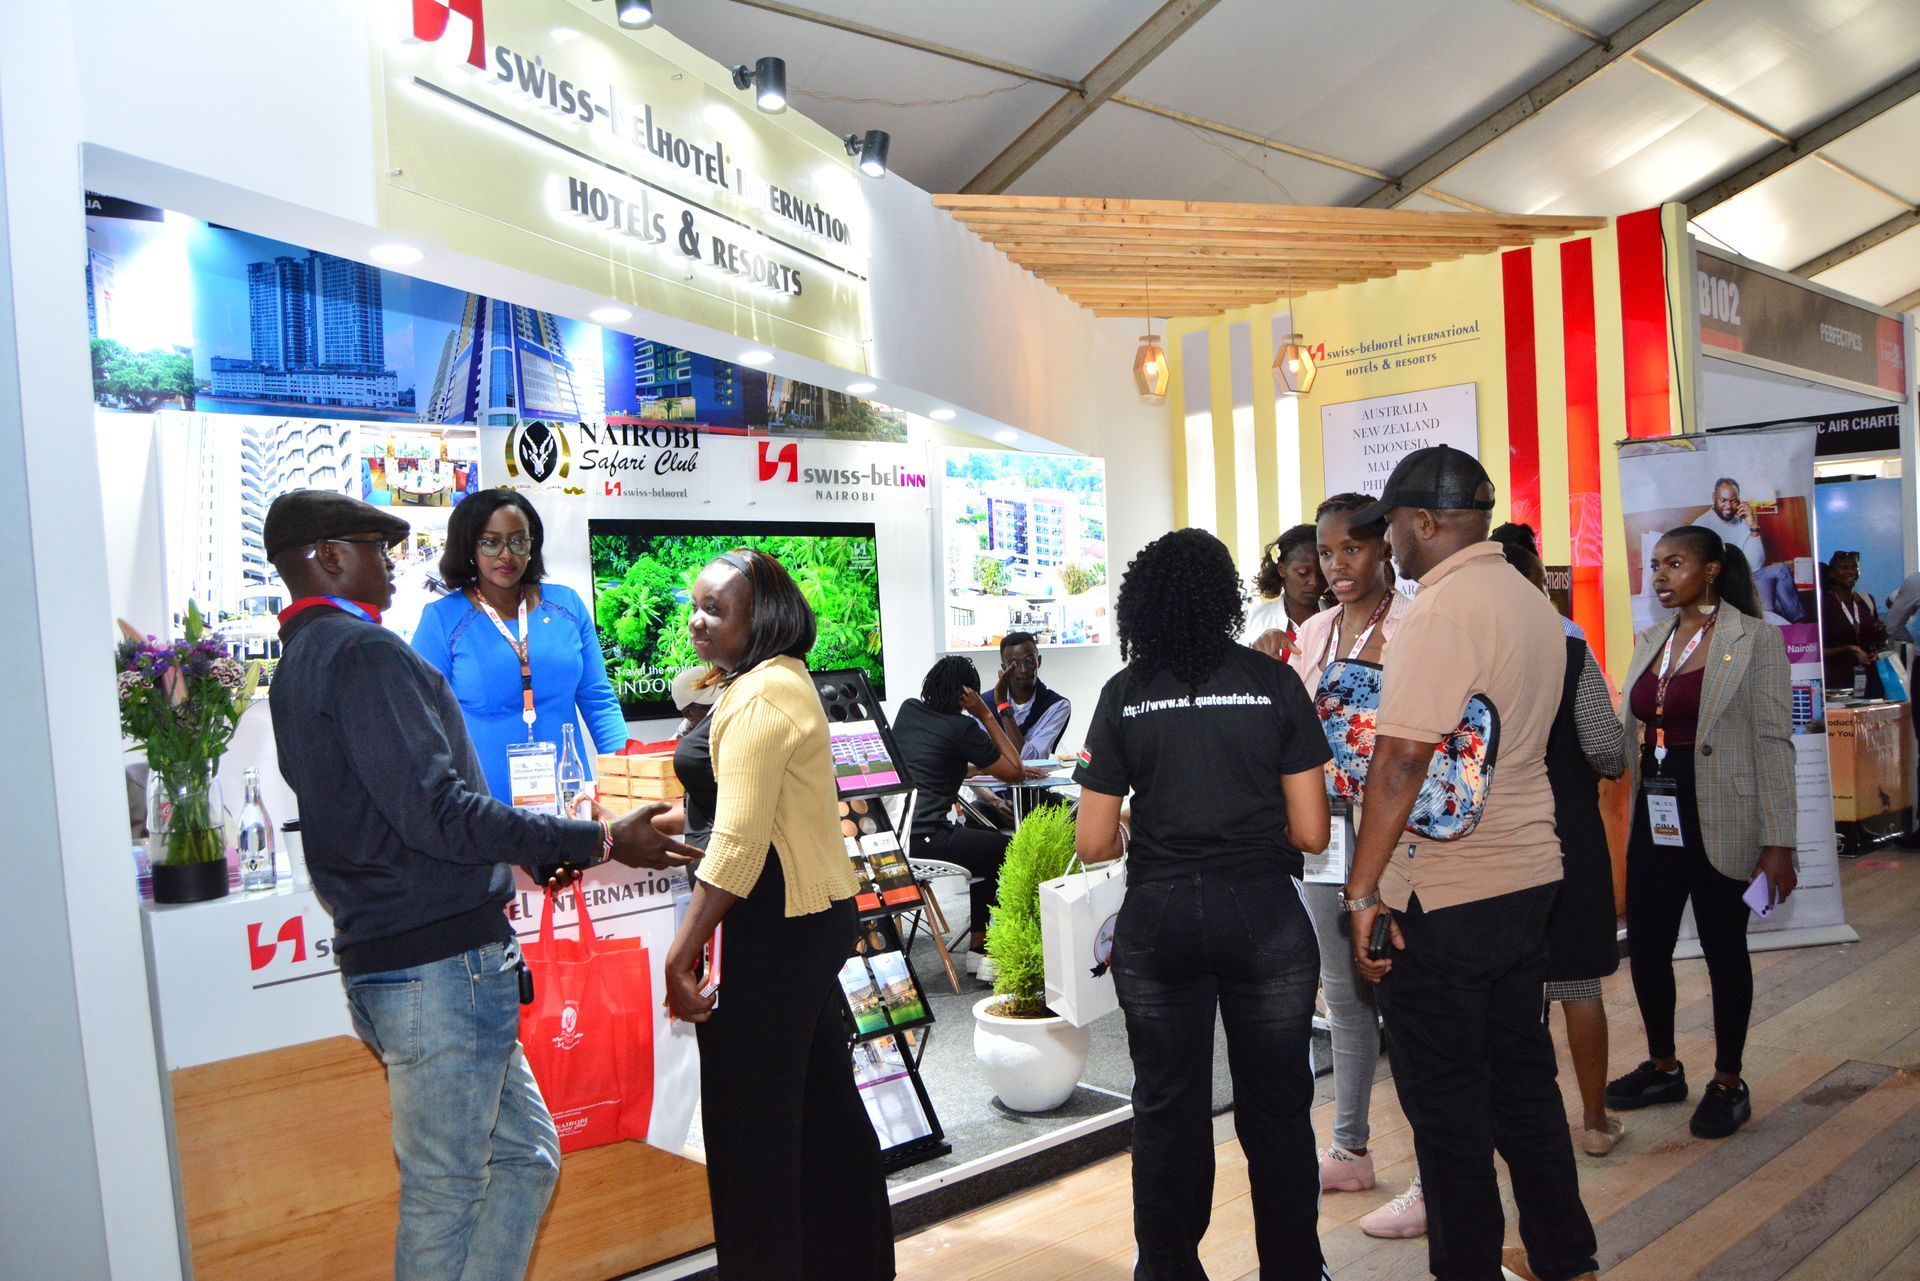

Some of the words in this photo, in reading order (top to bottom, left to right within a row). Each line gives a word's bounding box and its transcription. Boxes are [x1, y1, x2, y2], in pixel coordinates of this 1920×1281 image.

[679, 210, 701, 259] &
[712, 236, 802, 296] RESORTS
[1698, 271, 1741, 326] B102
[1382, 358, 1391, 370] &
[1395, 353, 1437, 368] RESORTS
[1361, 401, 1428, 421] AUSTRALIA
[1353, 426, 1380, 439] NEW
[1383, 418, 1440, 435] ZEALAND
[1828, 419, 1849, 432] AIR
[1852, 413, 1900, 430] CHARTE
[579, 422, 701, 449] NAIROBI
[1364, 438, 1429, 455] INDONESIA
[579, 450, 646, 477] Safari
[654, 449, 699, 475] Club
[1368, 460, 1399, 473] MALA
[815, 490, 874, 501] NAIROBI
[1787, 643, 1817, 653] Nairobi
[614, 666, 646, 677] Travel
[649, 664, 664, 675] the
[618, 678, 674, 694] INDON
[1123, 693, 1271, 717] ttp://www.adquatesafaris.co
[552, 871, 670, 914] NTERNATIO
